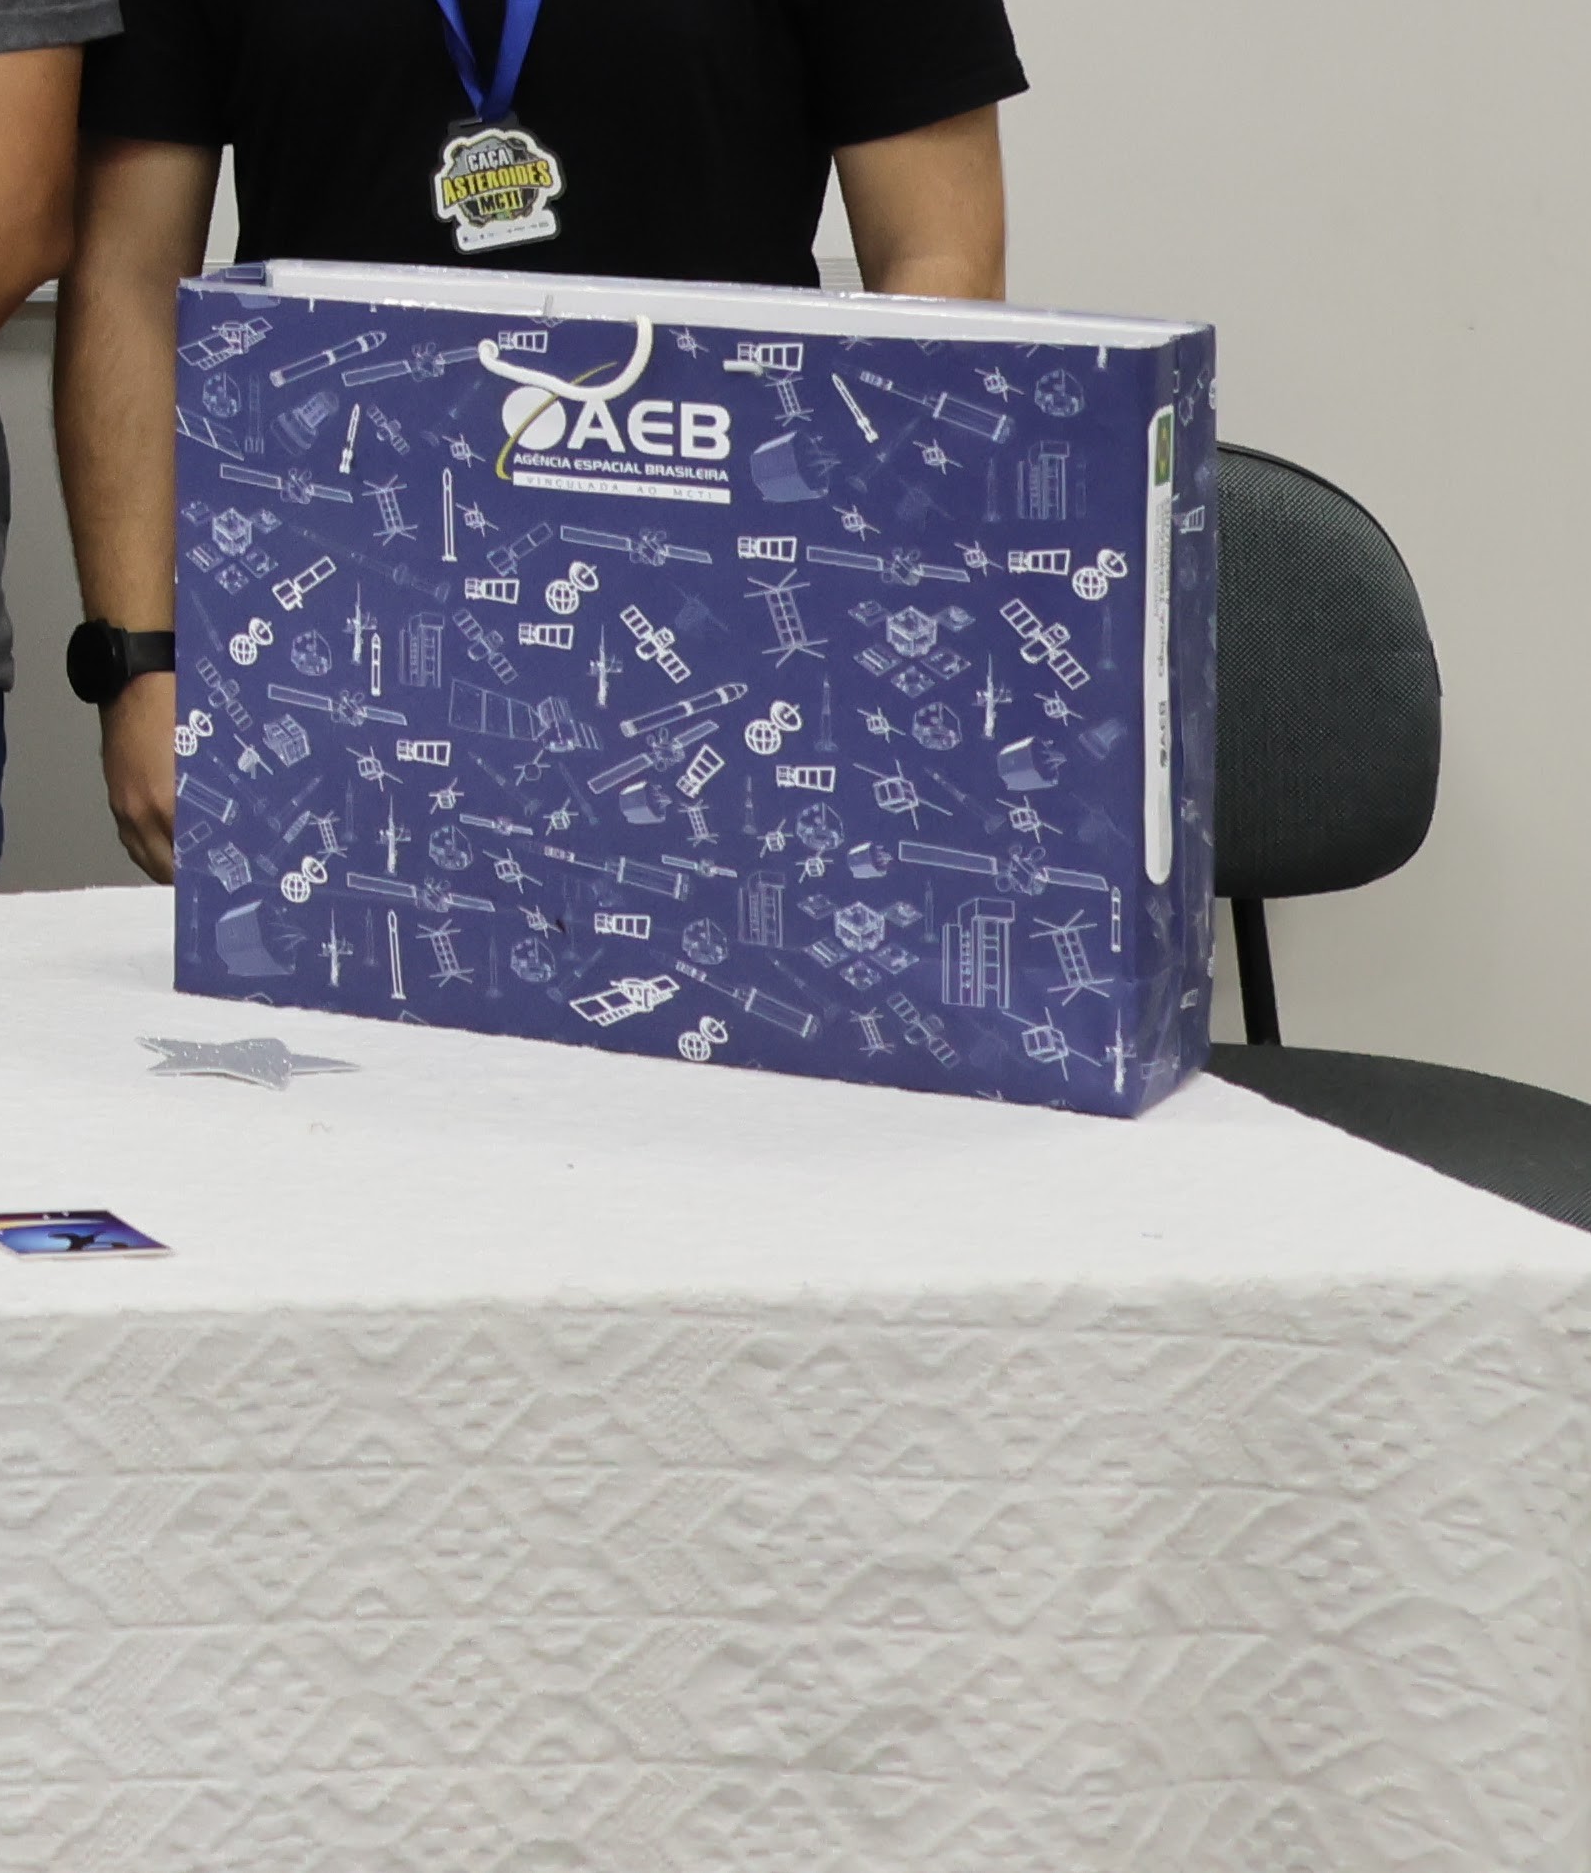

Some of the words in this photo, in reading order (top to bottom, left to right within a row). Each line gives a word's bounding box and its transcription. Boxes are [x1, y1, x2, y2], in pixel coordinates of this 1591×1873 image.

[442, 160, 553, 207] ASTEROIDES
[479, 191, 520, 213] MCTI
[567, 399, 731, 460] AEB
[513, 452, 571, 469] AGÊNCIA
[573, 459, 642, 475] ESPACIAL
[644, 463, 730, 482] BRASILEIRA
[526, 477, 620, 493] VINCULADA
[636, 486, 657, 495] AO
[672, 488, 713, 500] MCTI
